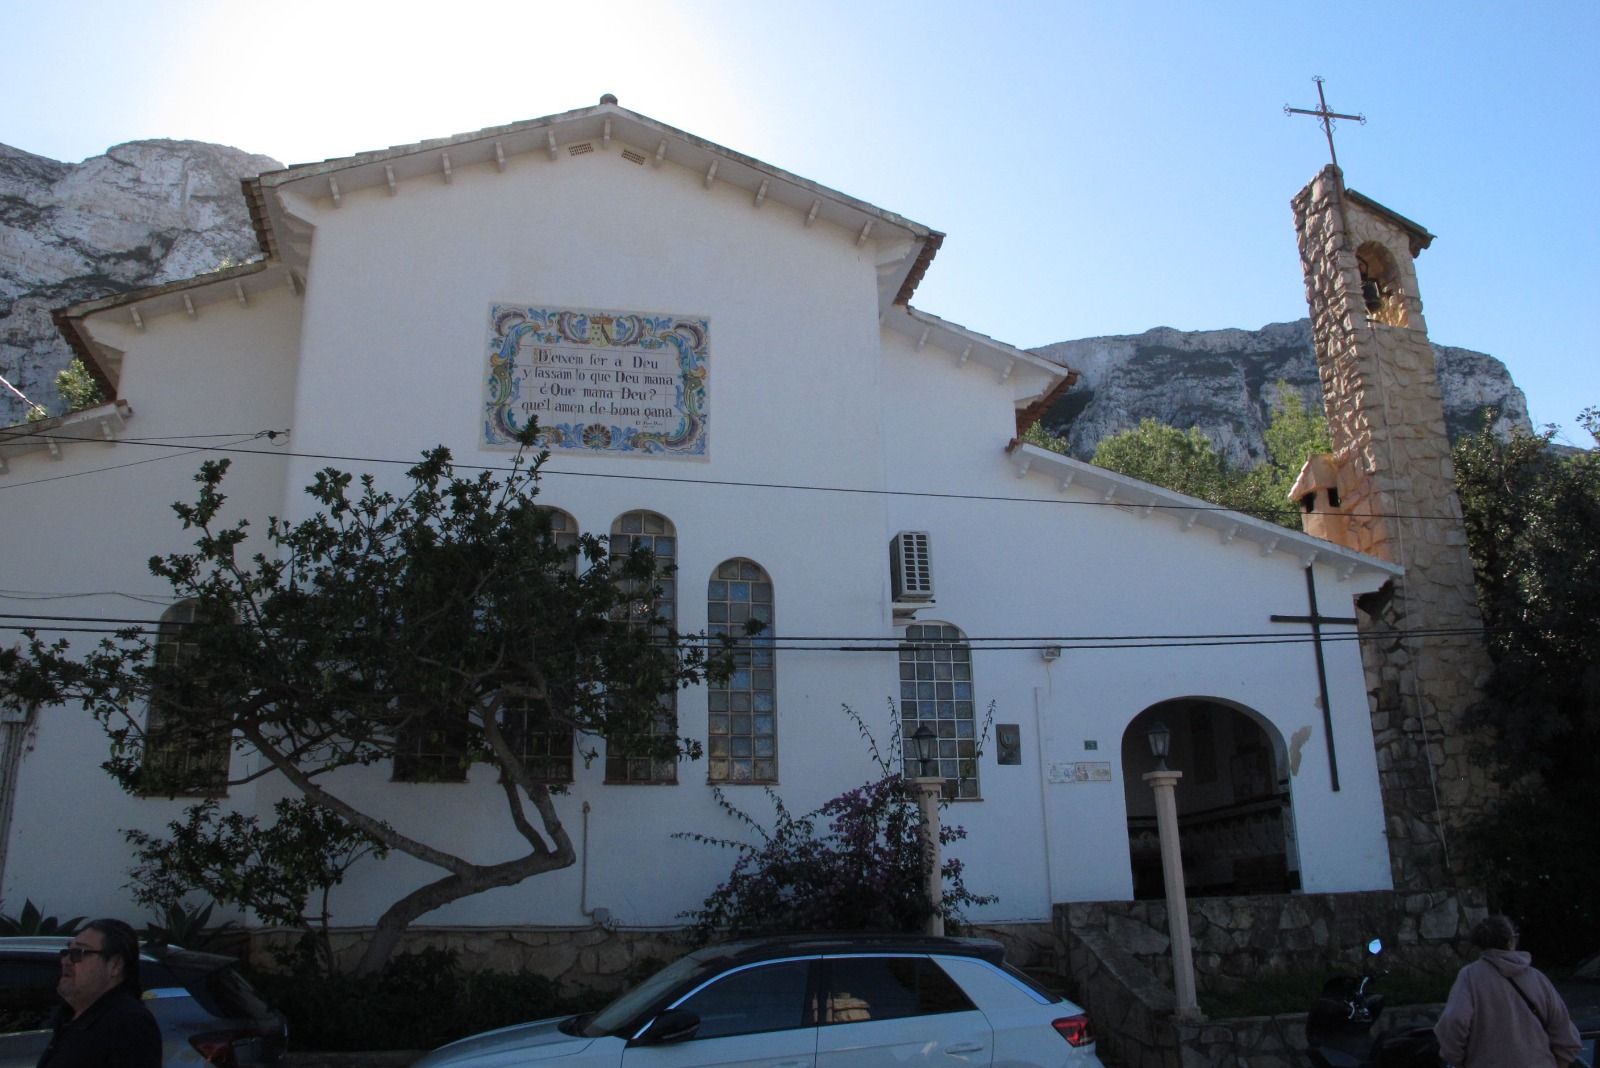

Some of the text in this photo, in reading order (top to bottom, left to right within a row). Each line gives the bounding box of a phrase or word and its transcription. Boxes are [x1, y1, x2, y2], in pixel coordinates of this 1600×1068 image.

[614, 358, 622, 367] a
[633, 356, 658, 369] Deu
[523, 368, 532, 381] y
[576, 368, 586, 381] lo
[590, 372, 611, 385] que
[615, 371, 639, 384] Deu
[644, 375, 673, 385] mana
[583, 388, 613, 399] mana
[622, 387, 657, 401] Deu?
[554, 402, 584, 413] amen
[589, 401, 606, 415] de
[610, 402, 640, 417] bona
[644, 407, 673, 419] gana
